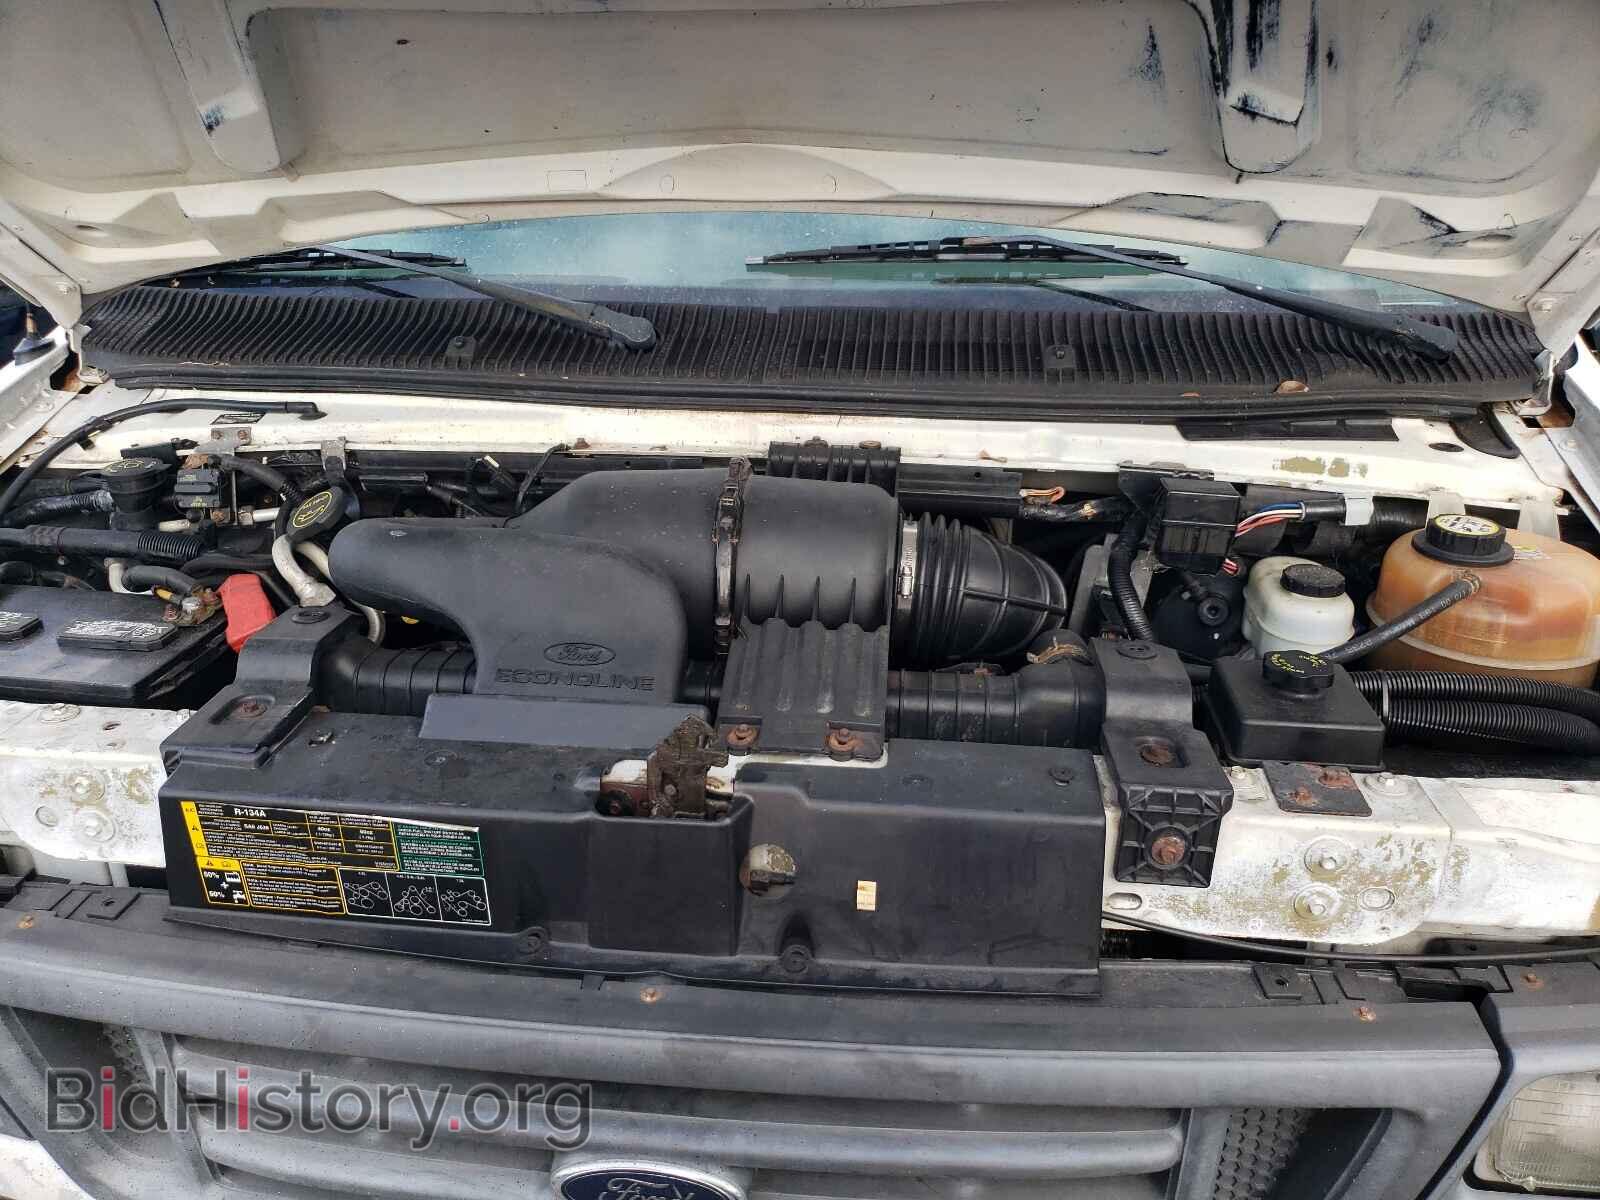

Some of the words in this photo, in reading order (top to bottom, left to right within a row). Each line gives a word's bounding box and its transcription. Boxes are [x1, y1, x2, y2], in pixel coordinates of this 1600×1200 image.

[557, 645, 602, 662] Ford
[495, 668, 655, 691] ECONOLINE
[233, 807, 267, 817] R-134A
